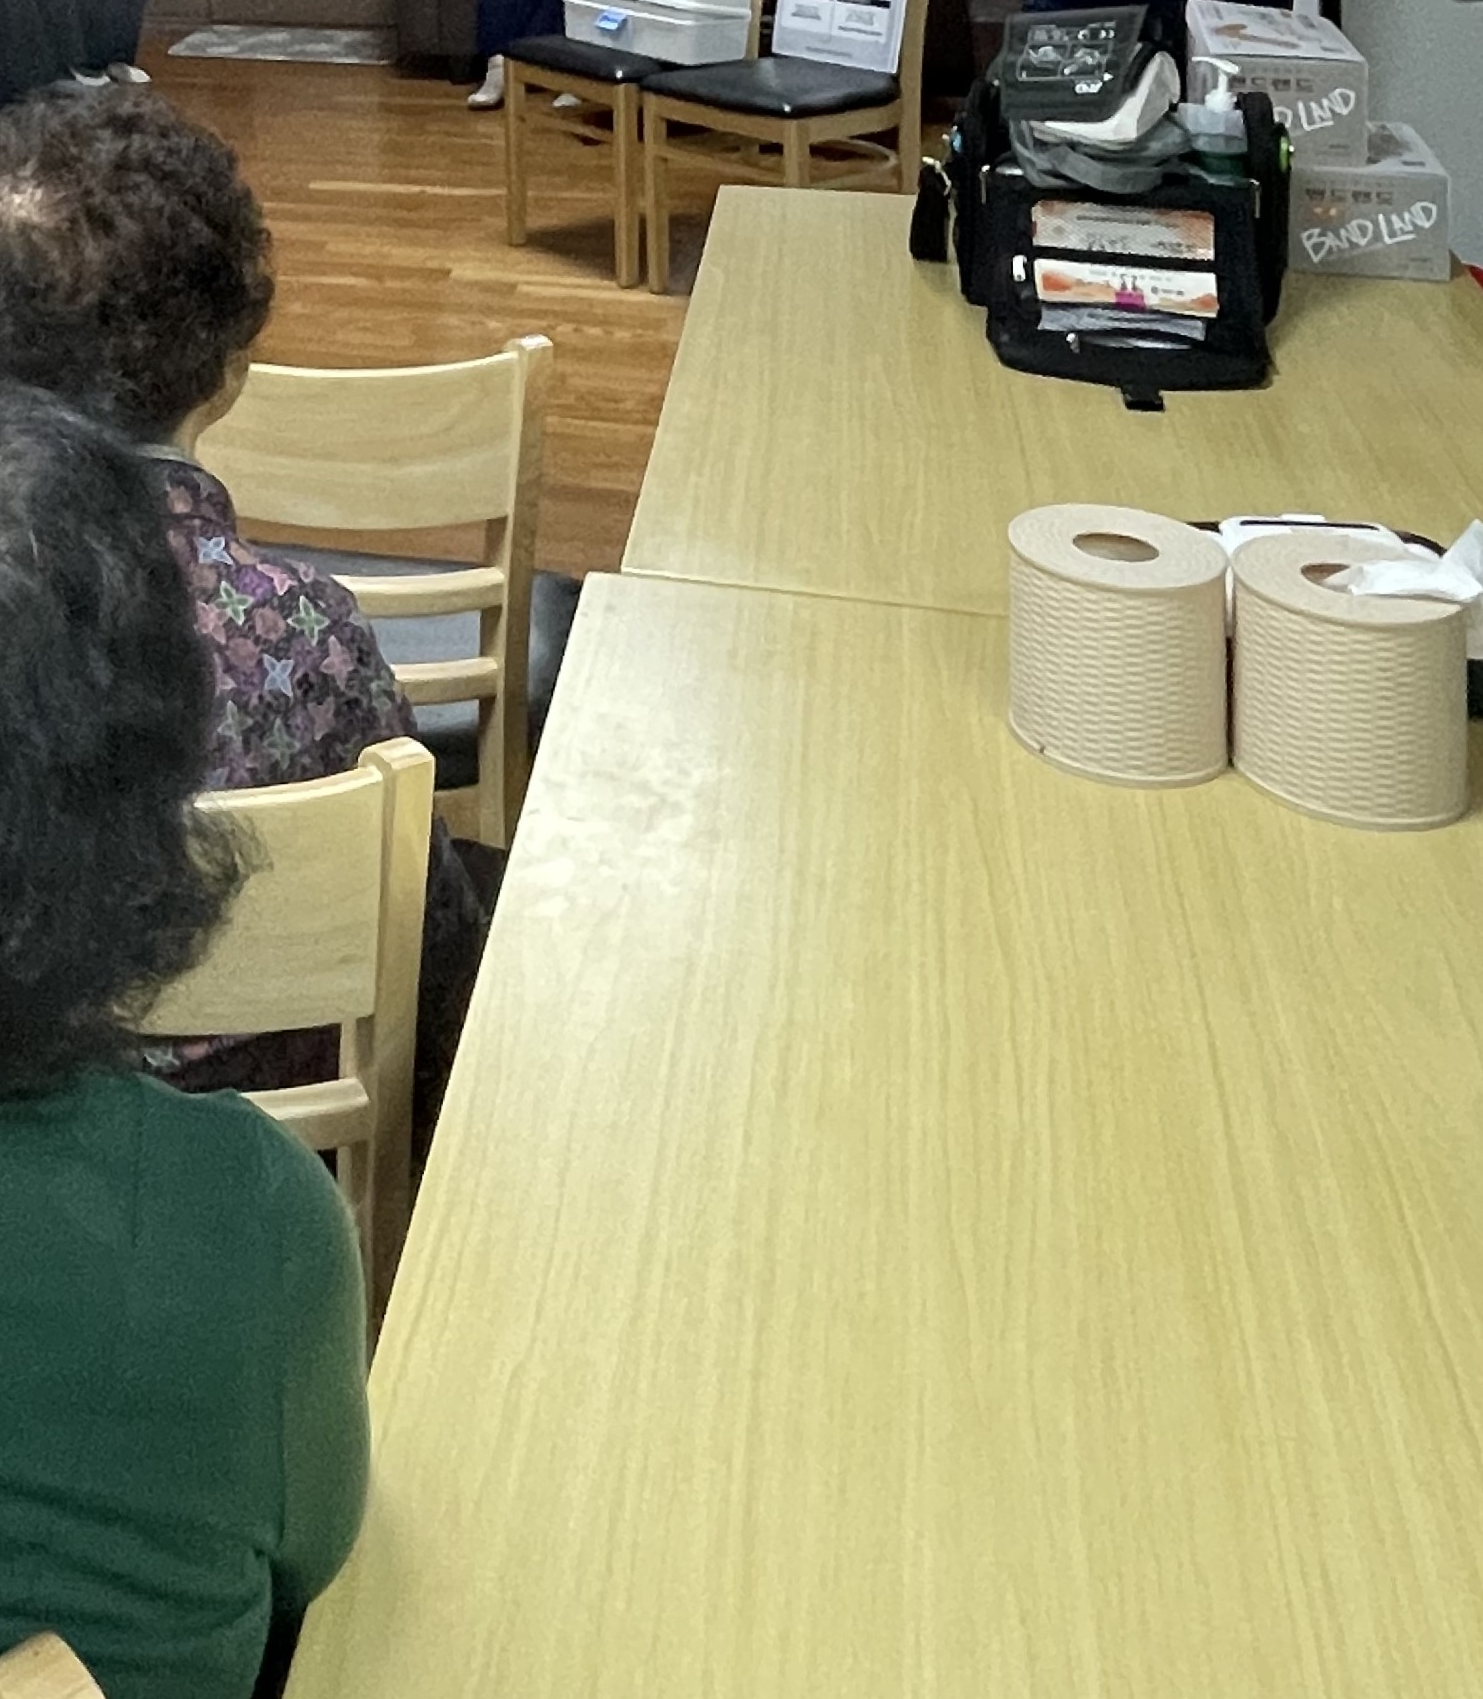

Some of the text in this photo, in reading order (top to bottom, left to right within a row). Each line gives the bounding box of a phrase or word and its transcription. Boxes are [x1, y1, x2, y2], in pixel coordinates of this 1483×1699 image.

[1297, 87, 1356, 132] LAND
[1300, 201, 1437, 264] BAND LAND
